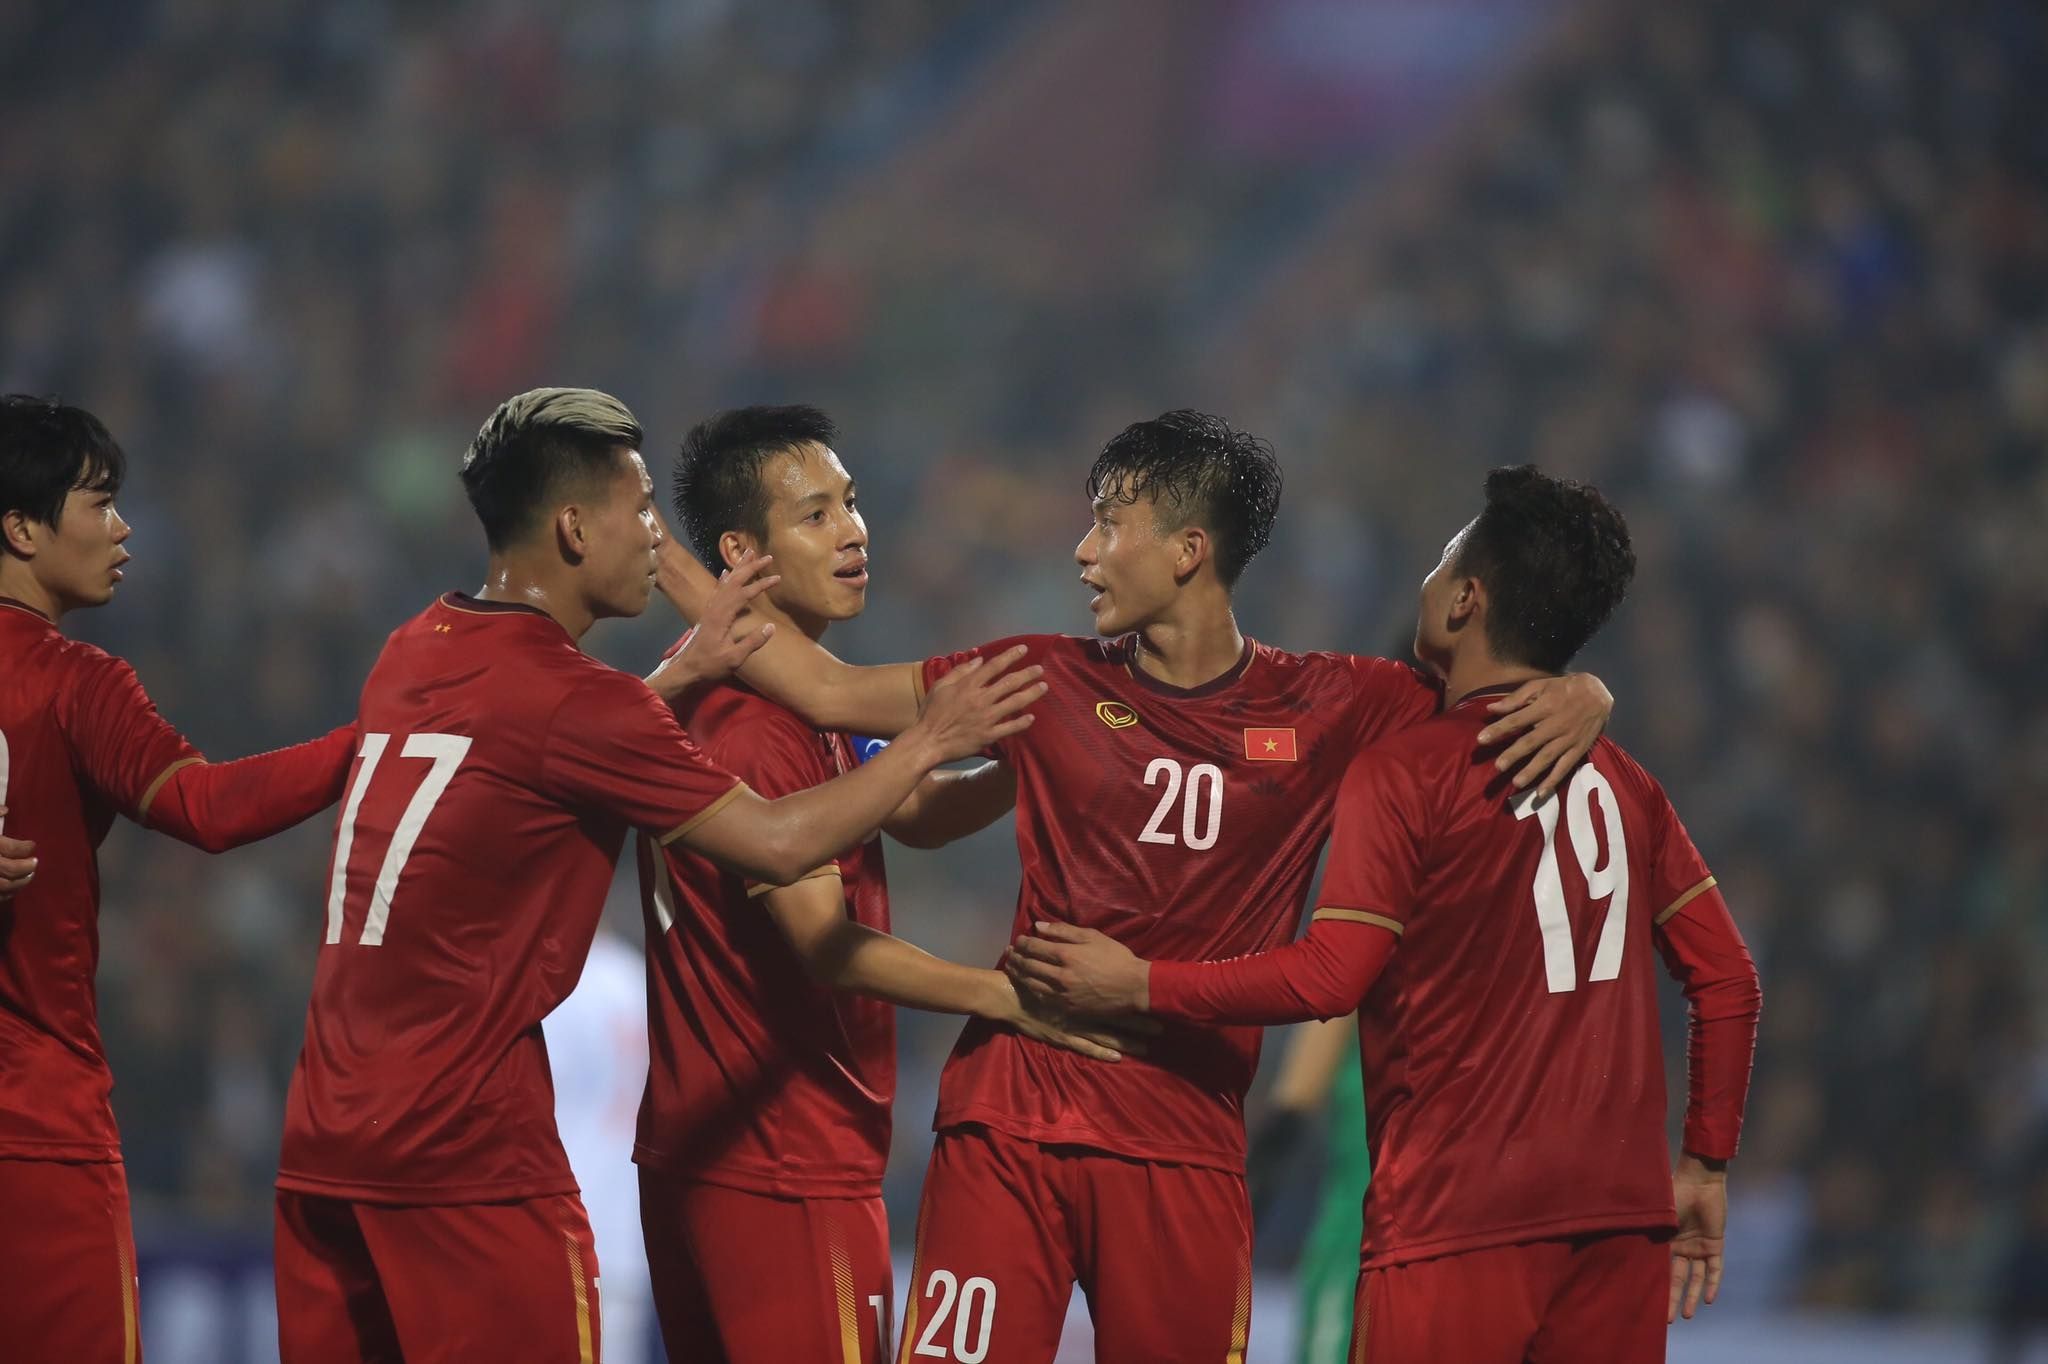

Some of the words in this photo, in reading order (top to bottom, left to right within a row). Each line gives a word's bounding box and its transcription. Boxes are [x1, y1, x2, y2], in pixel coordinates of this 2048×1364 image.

[325, 732, 473, 946] 17
[1137, 757, 1224, 850] 20
[1508, 762, 1629, 993] 19
[913, 1269, 997, 1364] 20
